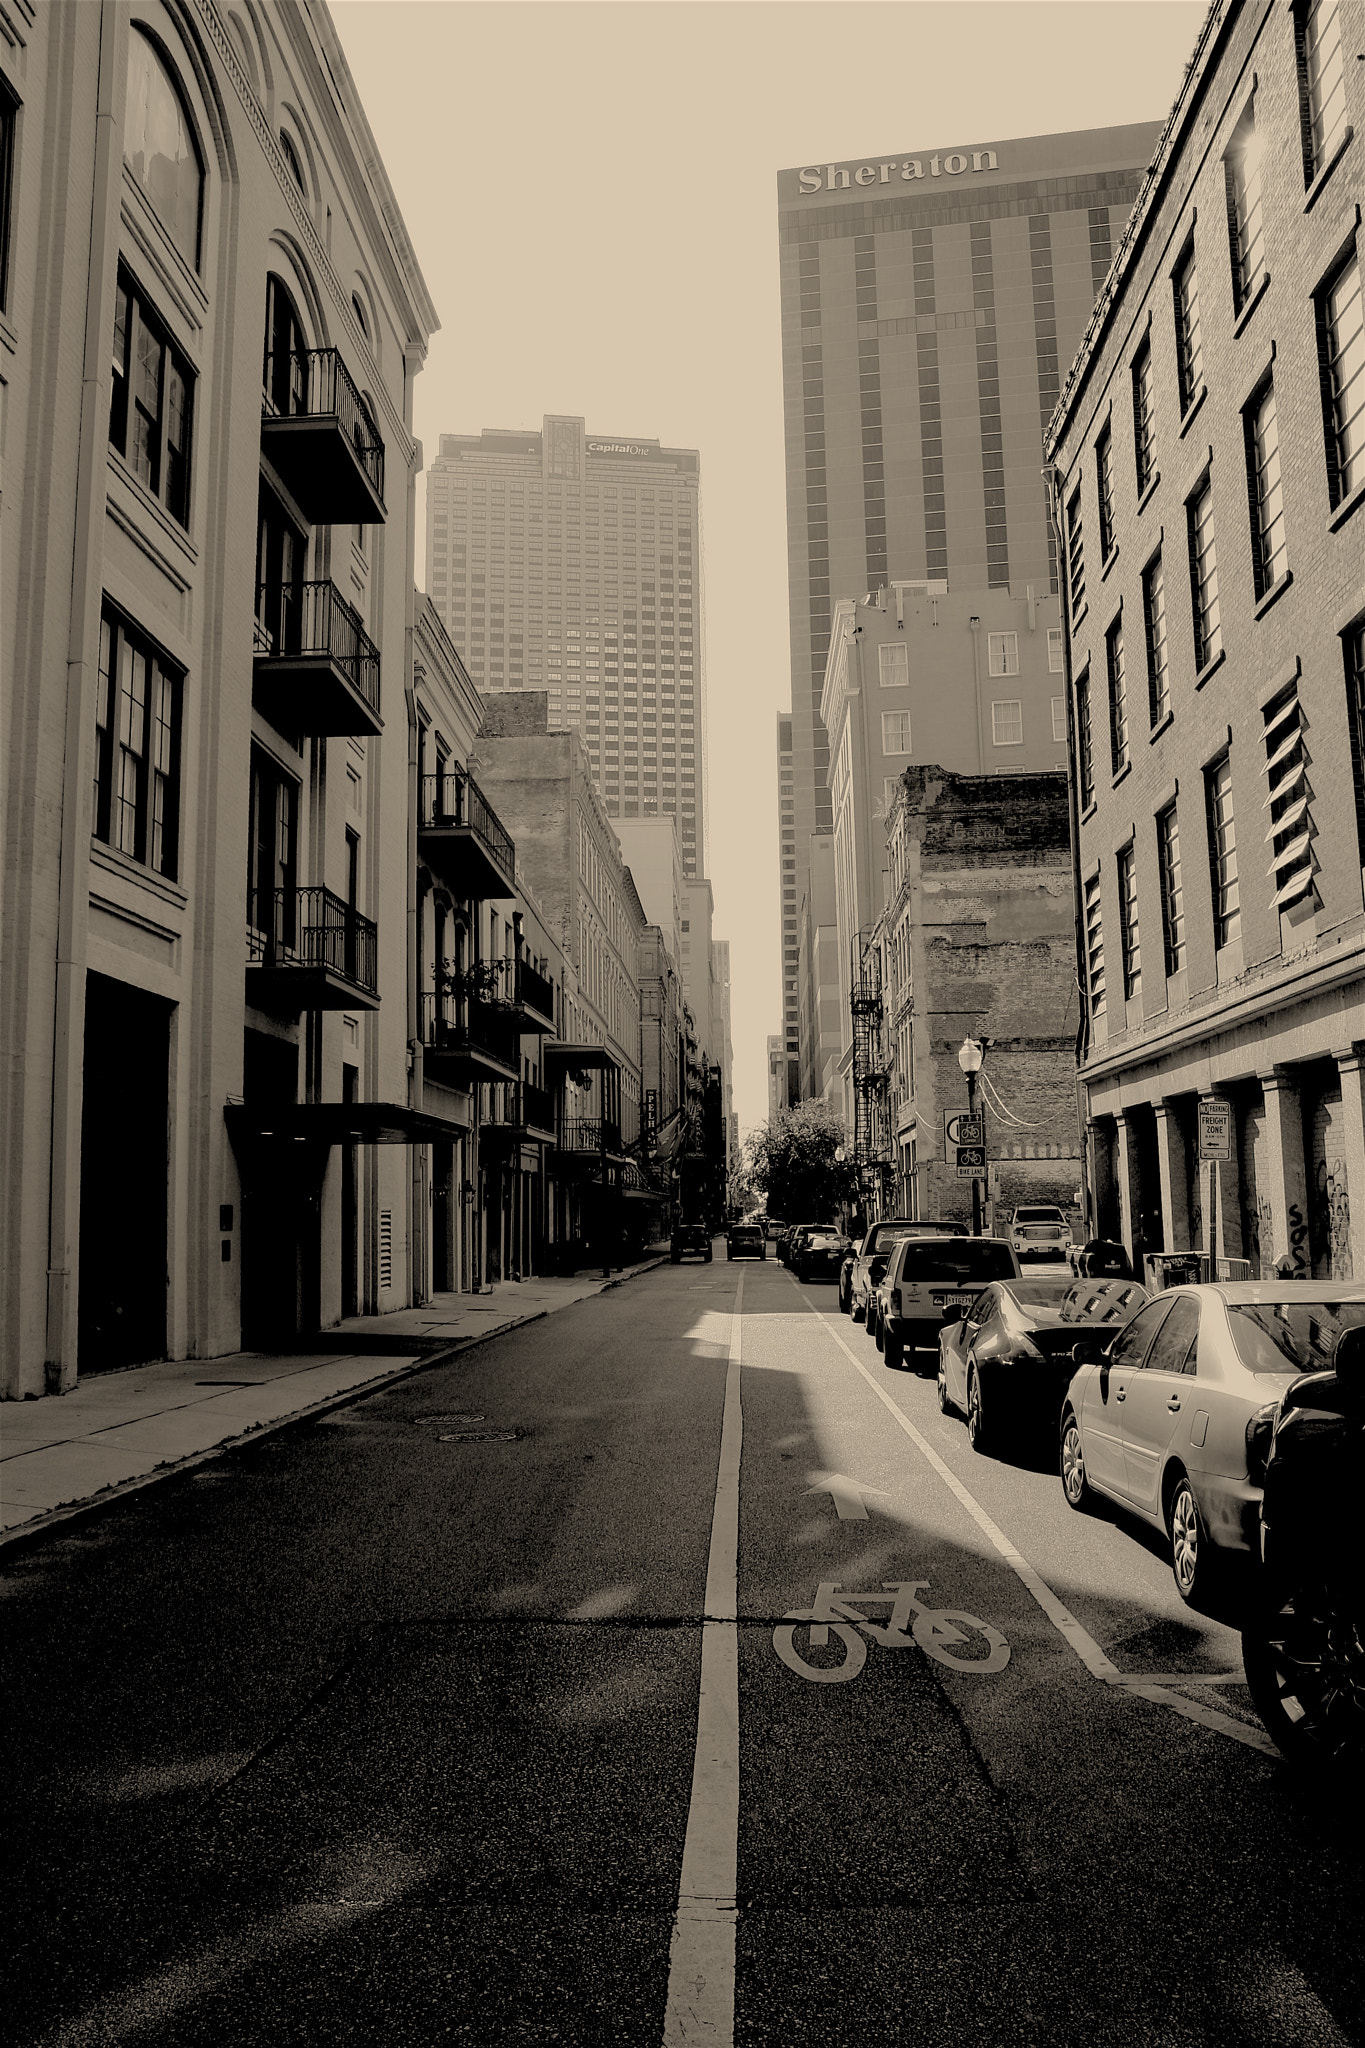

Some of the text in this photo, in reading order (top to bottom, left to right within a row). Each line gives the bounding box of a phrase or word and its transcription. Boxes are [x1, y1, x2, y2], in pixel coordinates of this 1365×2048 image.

[799, 150, 1000, 194] Sheraton
[1200, 1104, 1209, 1113] NO
[1202, 1116, 1227, 1124] FREIGHT
